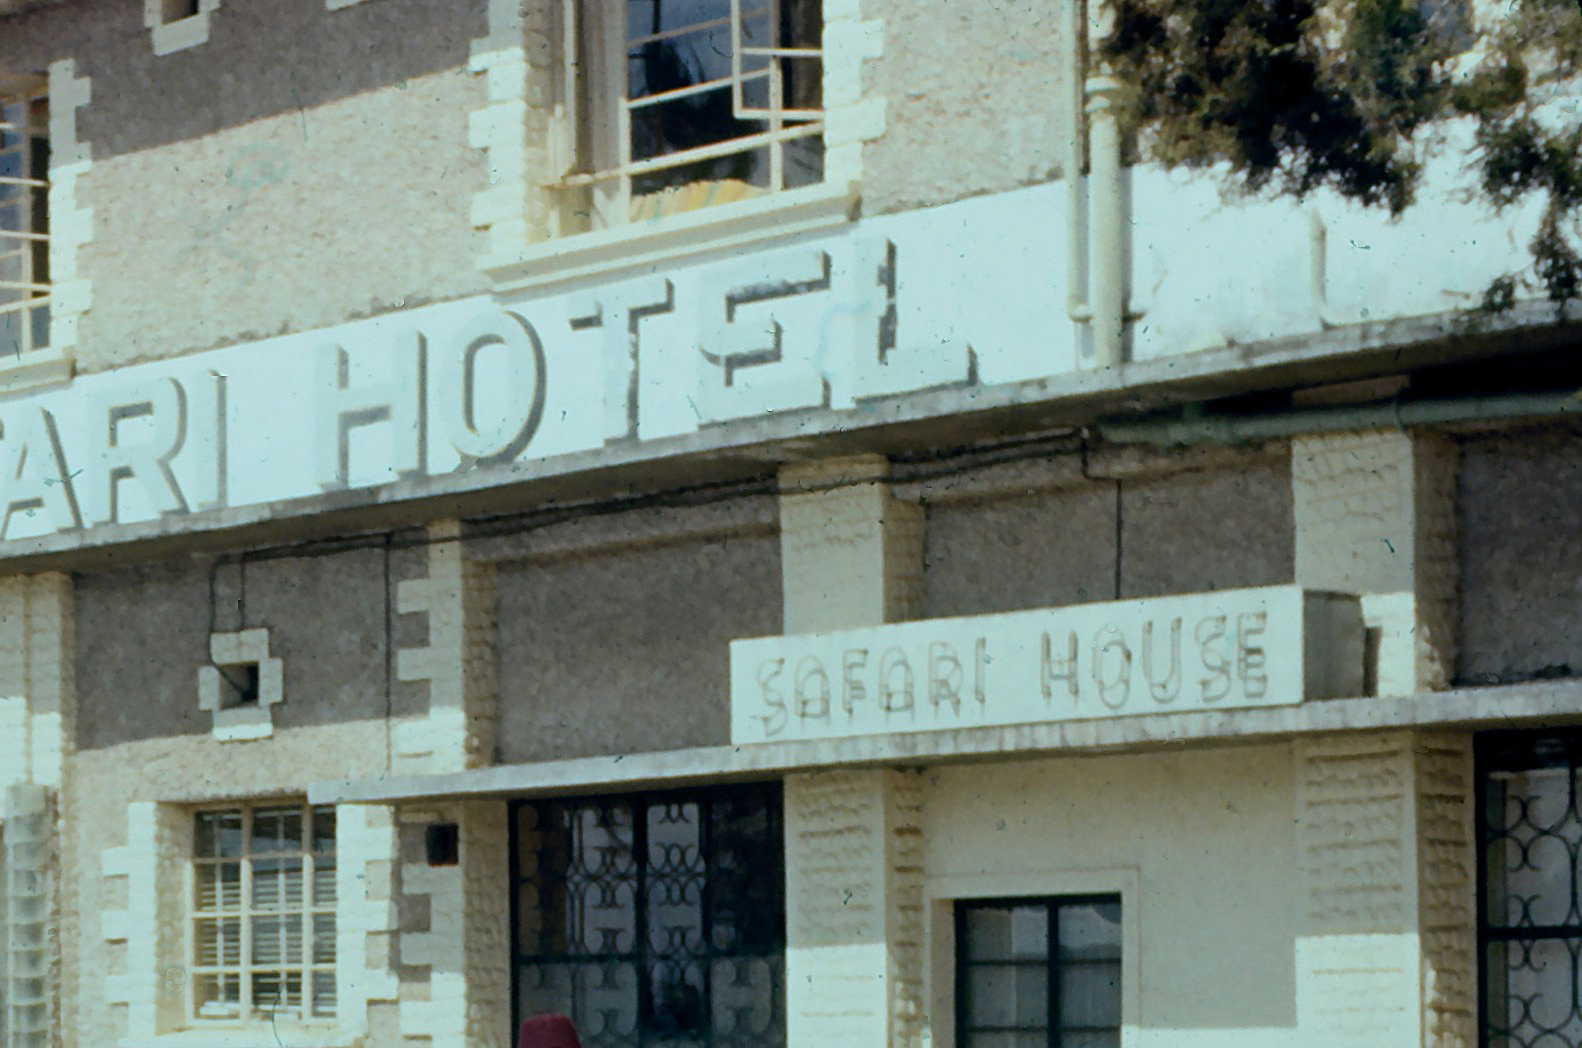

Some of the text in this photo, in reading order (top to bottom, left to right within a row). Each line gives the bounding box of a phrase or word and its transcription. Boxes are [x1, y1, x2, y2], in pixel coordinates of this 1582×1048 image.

[310, 236, 978, 494] HOTEL
[755, 610, 1269, 737] SAFARI HOUSE
